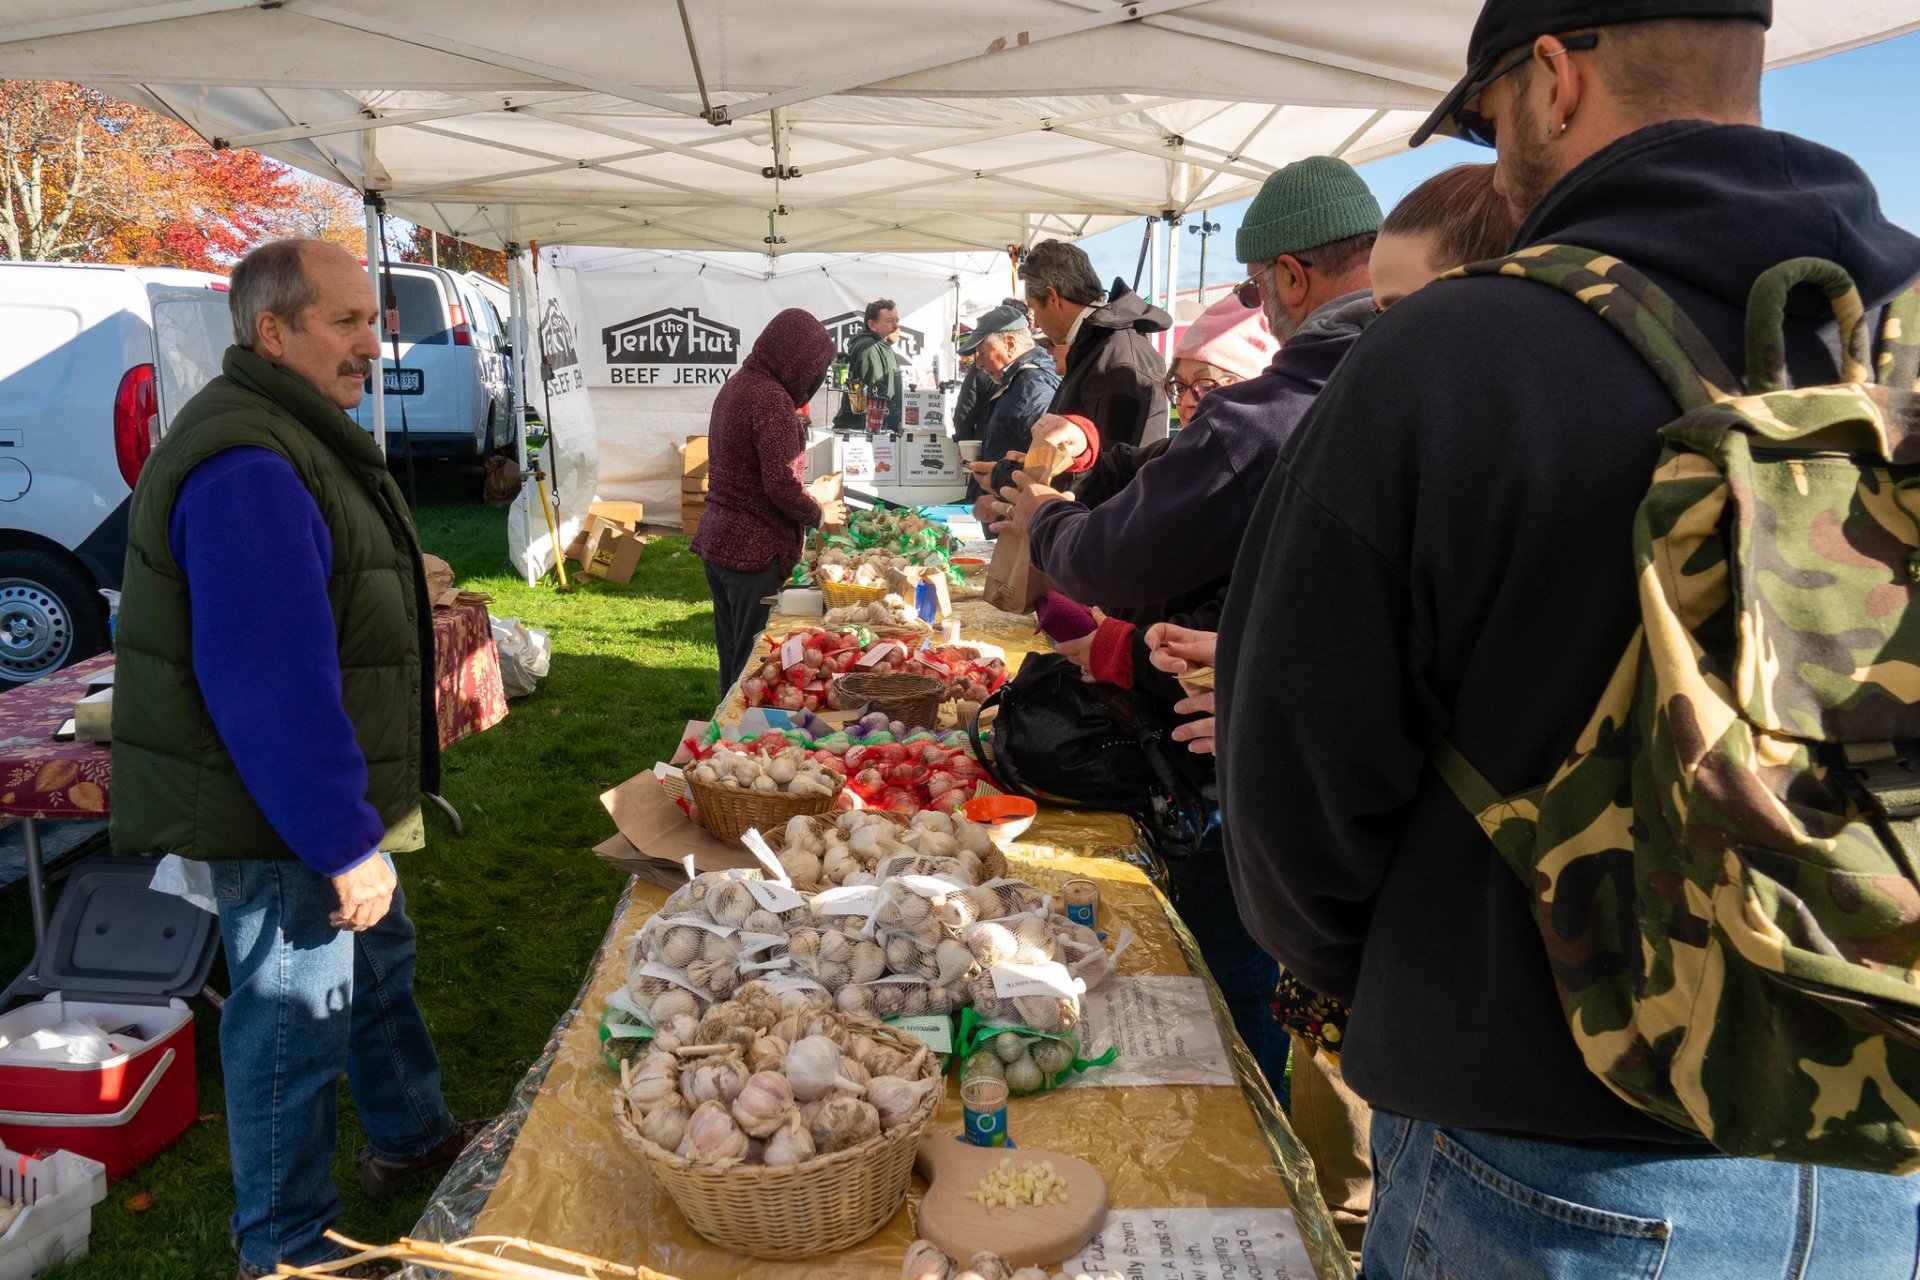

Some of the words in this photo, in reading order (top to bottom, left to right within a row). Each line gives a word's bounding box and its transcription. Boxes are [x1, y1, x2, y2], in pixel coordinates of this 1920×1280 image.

[611, 321, 680, 357] Jerky
[687, 311, 734, 355] Hut
[661, 321, 684, 333] the
[848, 323, 863, 335] th
[611, 368, 660, 384] BEEF
[673, 368, 732, 384] JERKY
[1122, 1221, 1139, 1256] Grown
[1236, 1228, 1248, 1237] a
[1212, 1237, 1237, 1280] ngering
[1240, 1239, 1255, 1261] and
[1127, 1261, 1145, 1280] ally
[1161, 1260, 1177, 1270] A
